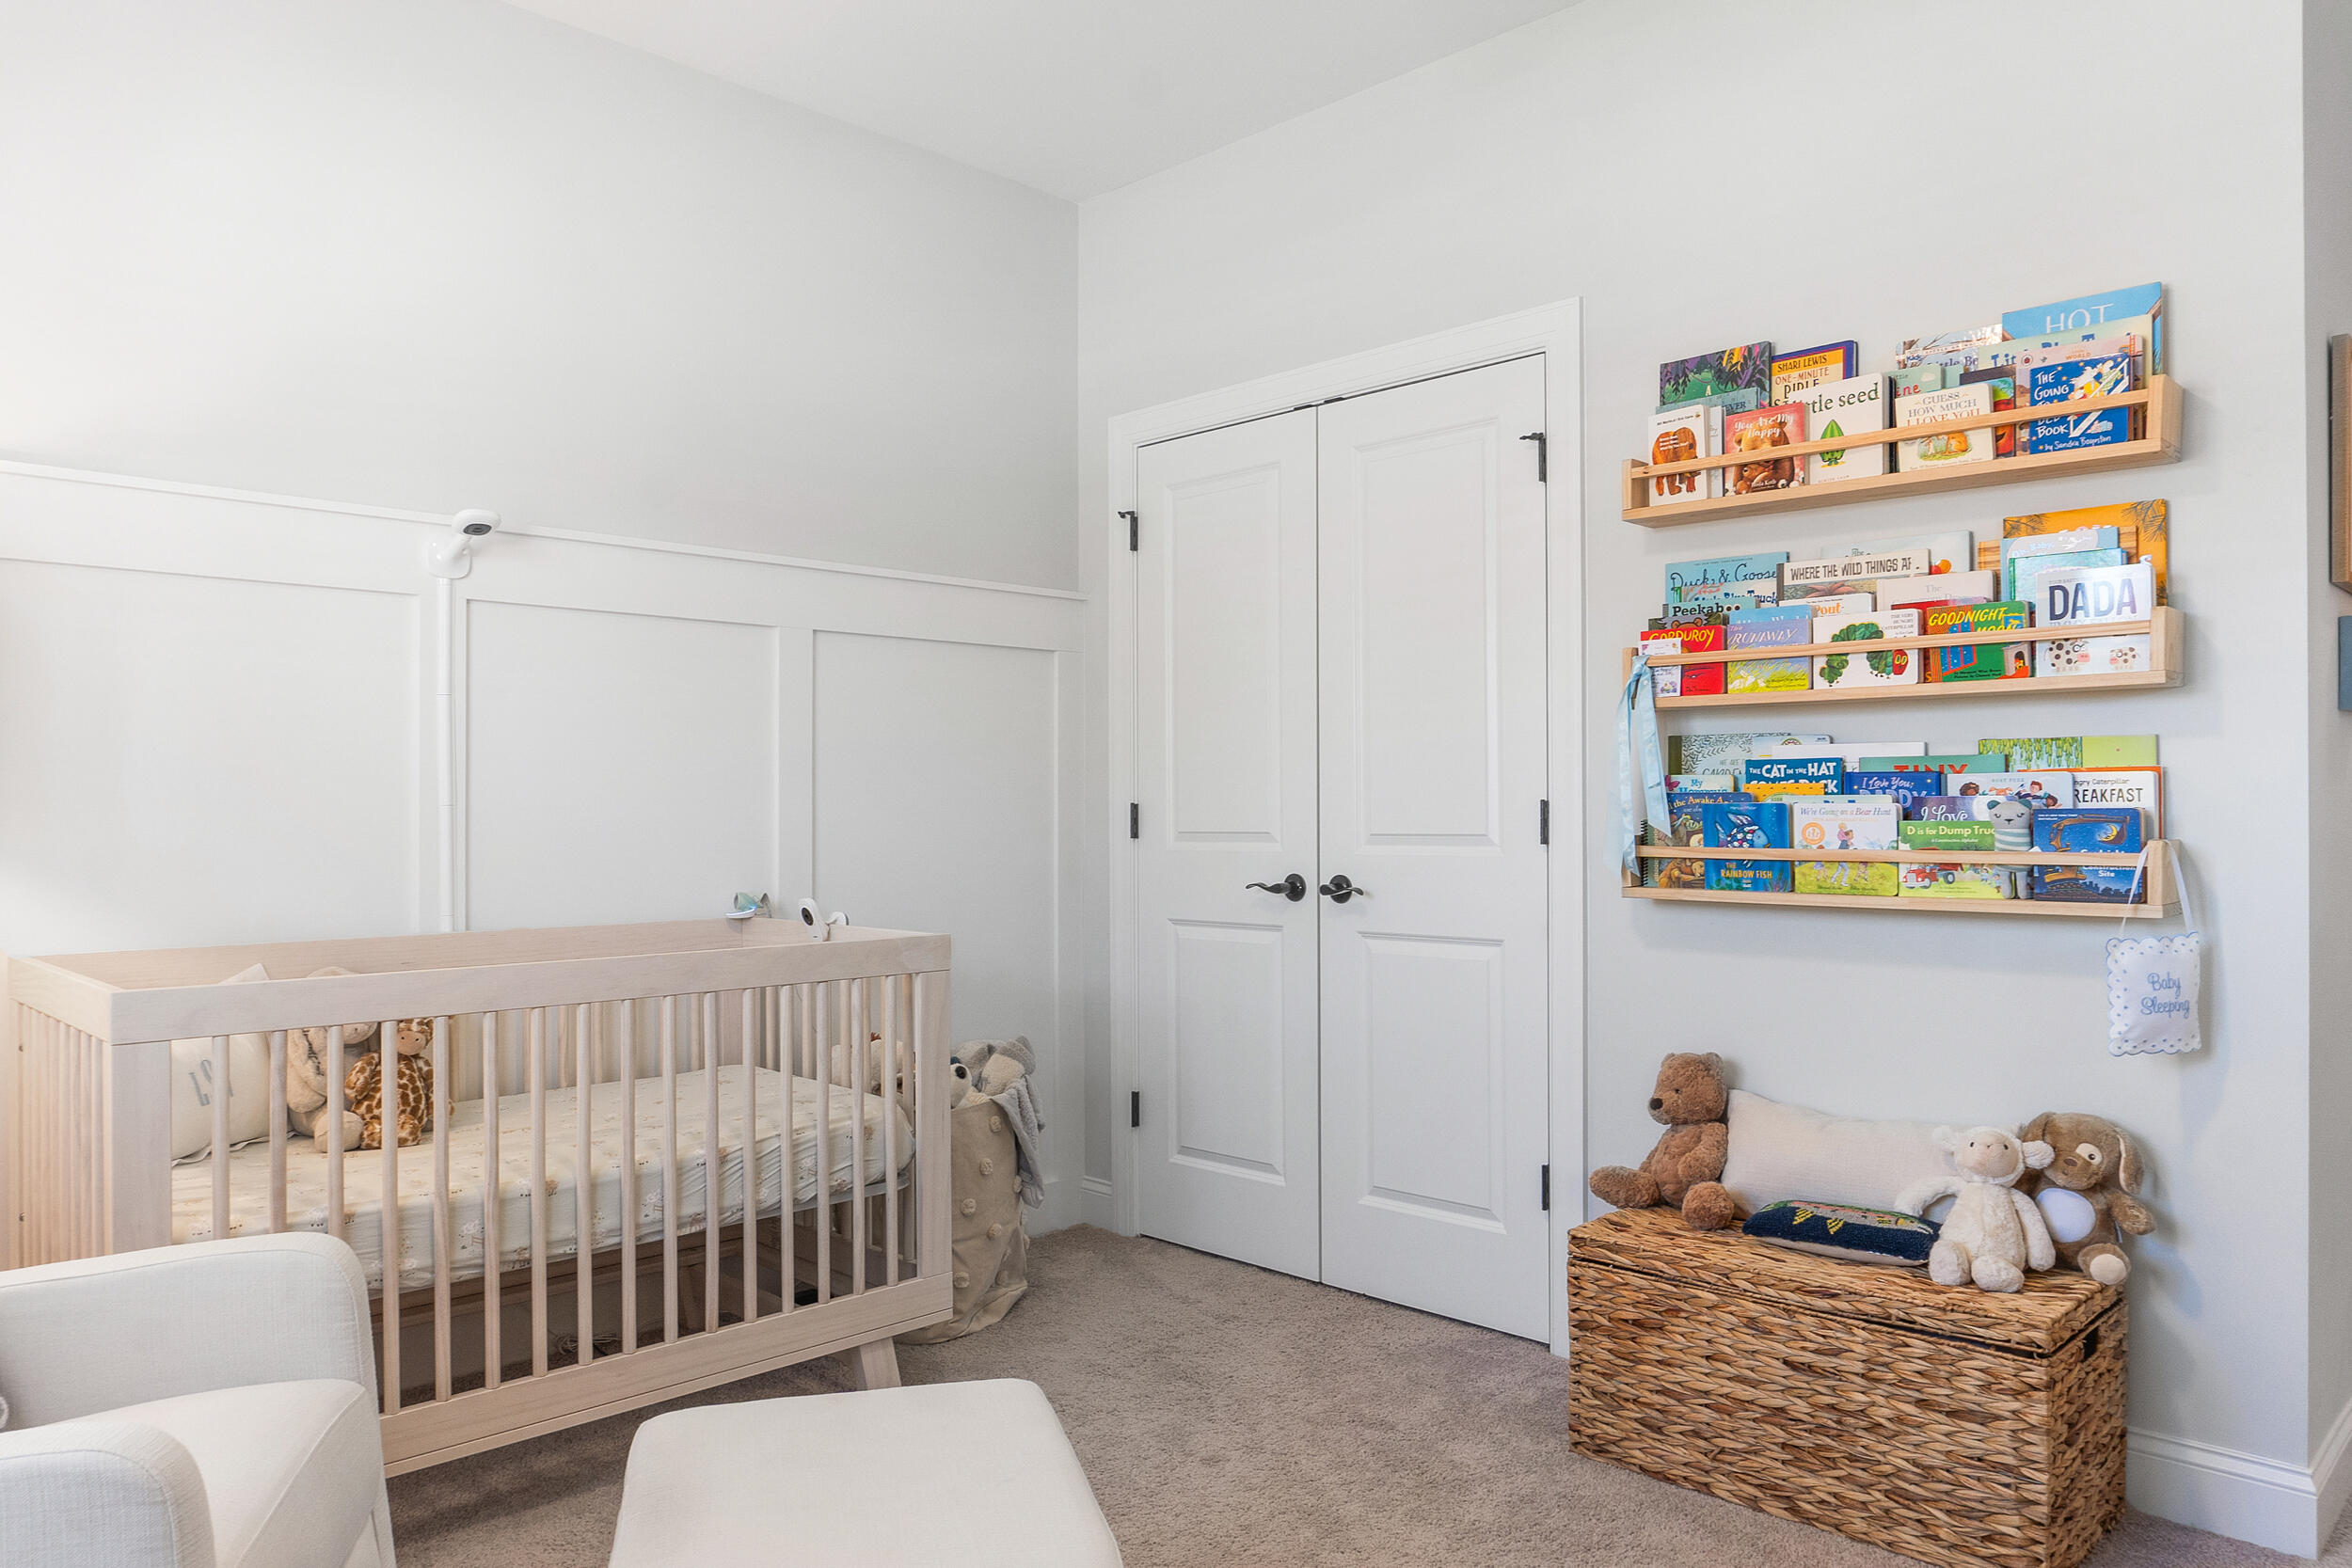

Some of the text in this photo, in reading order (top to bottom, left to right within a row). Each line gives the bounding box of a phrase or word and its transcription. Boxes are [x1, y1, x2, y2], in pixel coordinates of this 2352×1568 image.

[2045, 303, 2114, 334] HOT
[1777, 355, 1827, 372] SHARI LEWIS
[2035, 370, 2058, 385] THE
[1838, 382, 1880, 407] seed
[1922, 391, 1960, 405] GUESS
[2034, 385, 2069, 400] GOING
[1908, 398, 1977, 418] HOW MUCH
[1734, 420, 1754, 432] You
[1776, 413, 1794, 425] My
[2035, 424, 2069, 438] BOOK
[1747, 427, 1781, 438] Happy
[1734, 562, 1777, 582] Goose
[1790, 566, 1820, 580] WHERE
[1822, 563, 1837, 578] THE
[1841, 562, 1863, 576] WILD
[1865, 558, 1899, 574] THINGS
[2049, 578, 2137, 621] DADA
[1929, 607, 2008, 626] GOODNIGHT
[1762, 763, 1787, 778] CAT
[1807, 761, 1836, 776] HAT
[1862, 777, 1867, 788] I
[1867, 776, 1889, 789] Love
[2074, 777, 2130, 788] ngry Caterpillar
[1687, 796, 1715, 804] Awake
[2074, 787, 2144, 802] REAKFAST
[1855, 807, 1871, 816] Bear
[1873, 807, 1891, 816] Hunt
[1930, 804, 1968, 821] Love
[1907, 826, 1915, 835] D
[1925, 827, 1937, 835] for
[1939, 826, 1972, 837] Dump
[1972, 825, 1995, 835] Truc
[1720, 869, 1772, 879] RAINBOW FISH
[2147, 971, 2181, 997] Baby
[2140, 996, 2190, 1020] Sleeping
